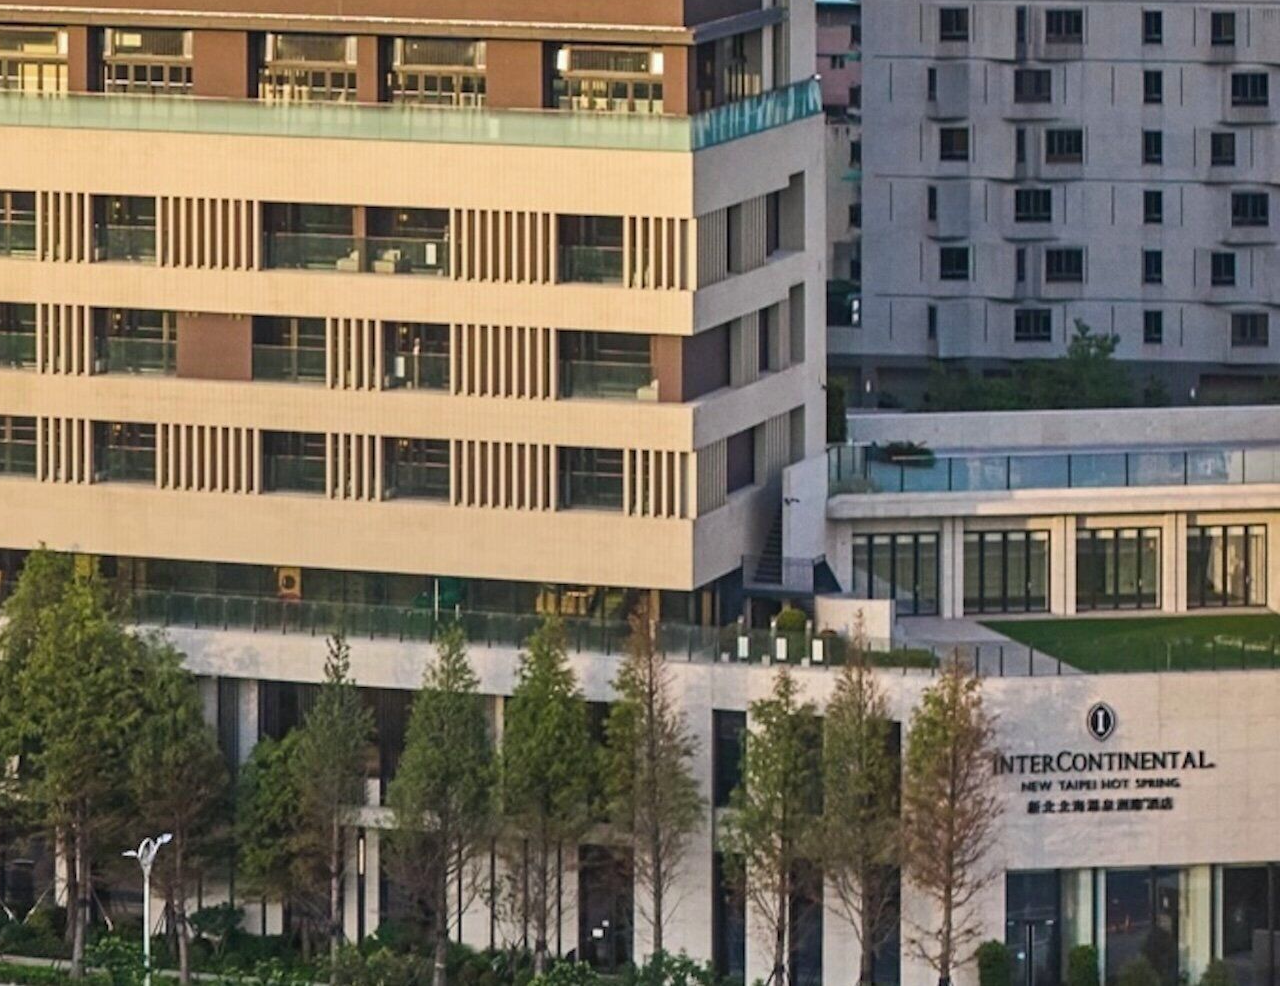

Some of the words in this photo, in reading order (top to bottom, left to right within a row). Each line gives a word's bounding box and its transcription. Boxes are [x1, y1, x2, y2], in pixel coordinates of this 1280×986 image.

[1021, 780, 1052, 792] NEW
[1059, 779, 1097, 791] TAIPEI
[1101, 778, 1129, 790] HOT
[1135, 777, 1181, 789] SPRING
